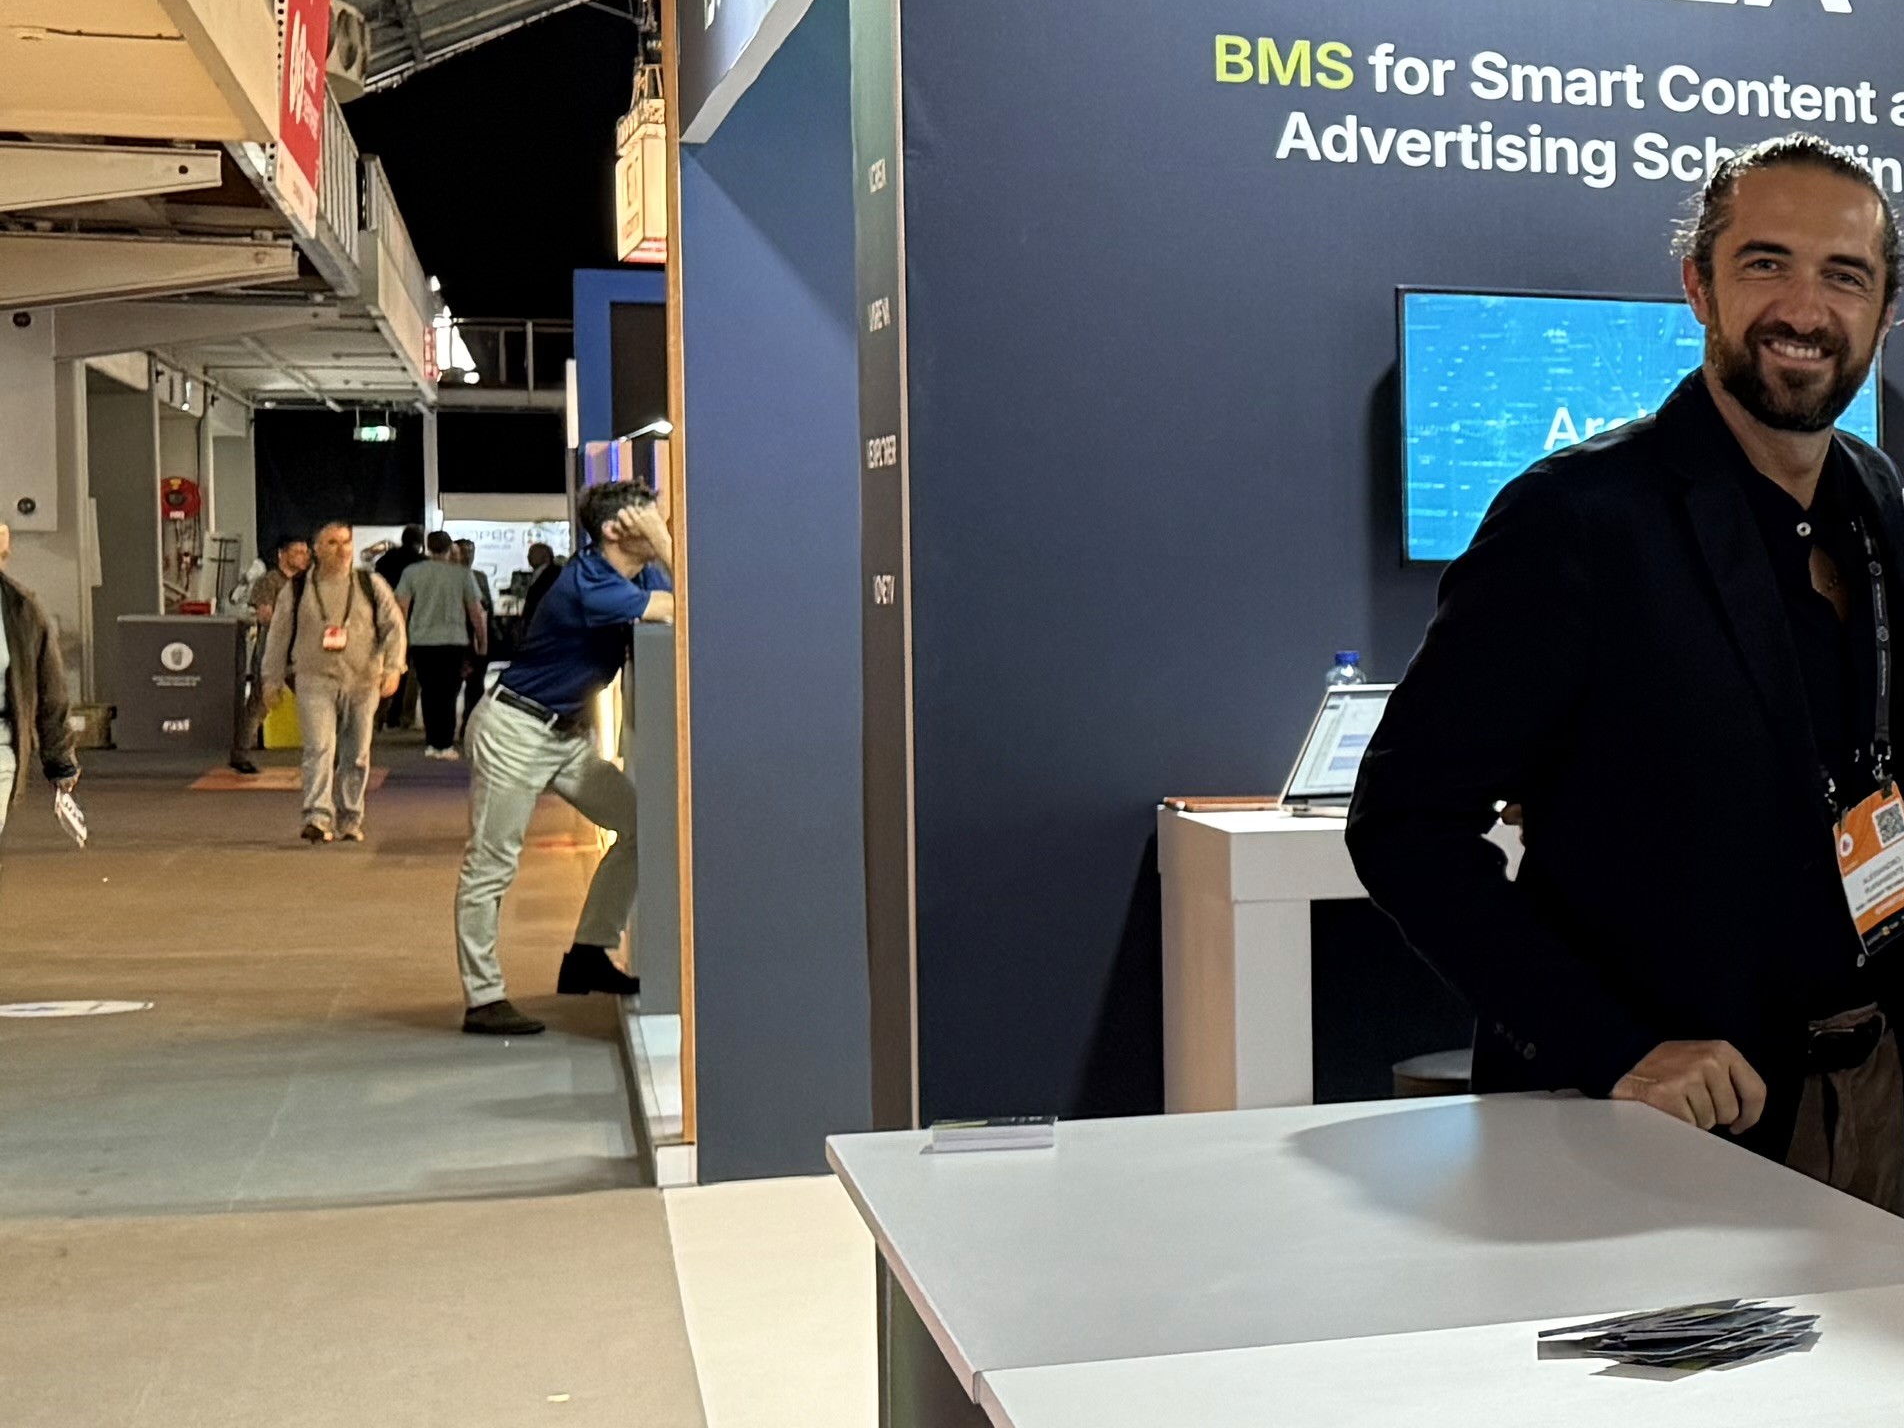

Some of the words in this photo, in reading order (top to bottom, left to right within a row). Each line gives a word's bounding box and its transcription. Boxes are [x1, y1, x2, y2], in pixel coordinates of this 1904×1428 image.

[1214, 34, 1354, 91] BMS
[1368, 43, 1455, 98] for
[1470, 51, 1644, 110] Smart
[1658, 65, 1876, 127] Content
[1276, 111, 1616, 187] Advertising
